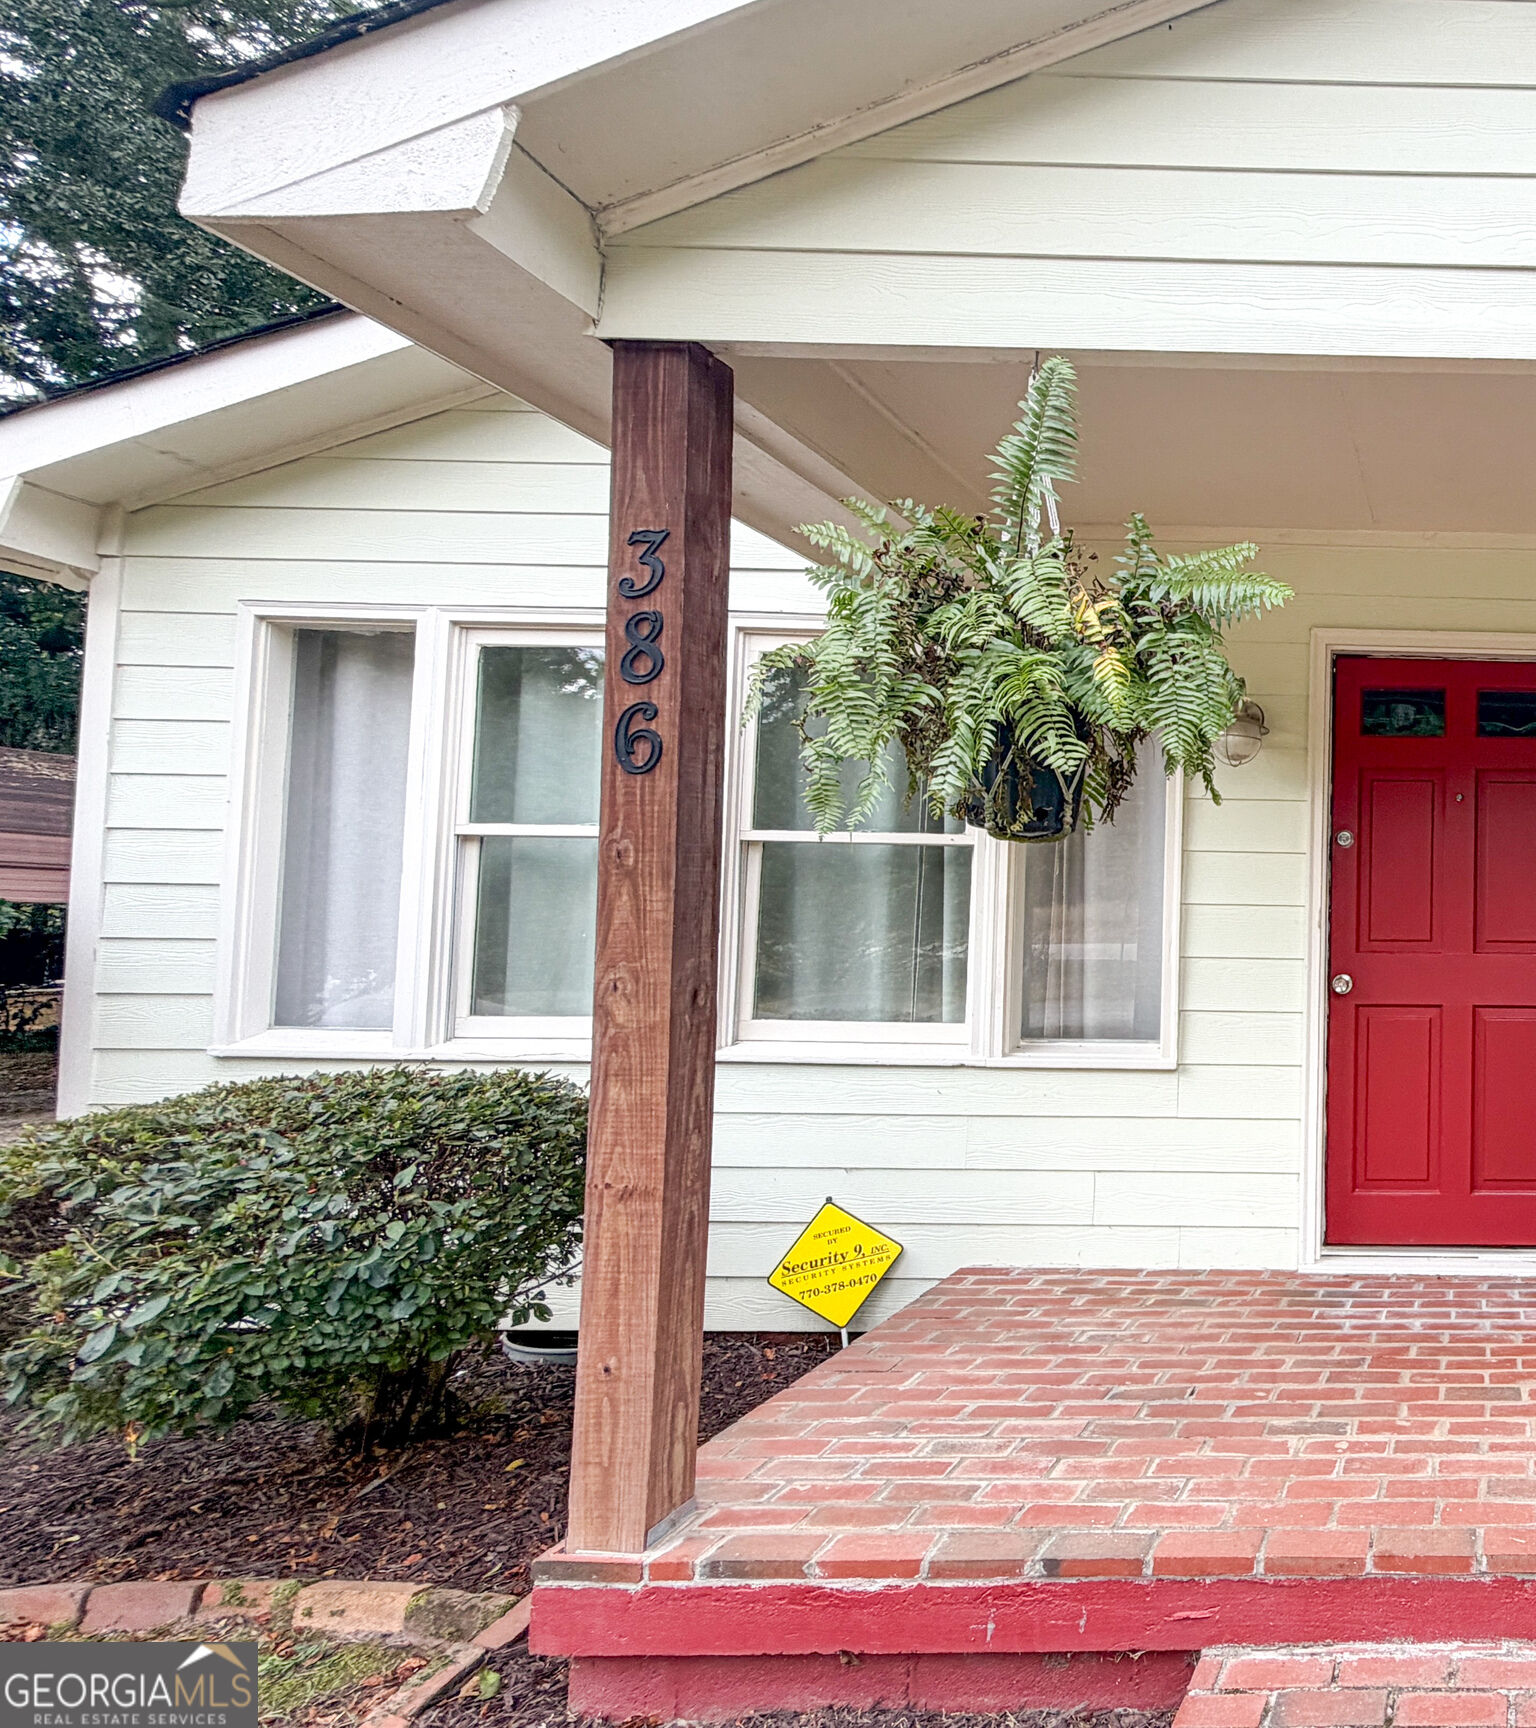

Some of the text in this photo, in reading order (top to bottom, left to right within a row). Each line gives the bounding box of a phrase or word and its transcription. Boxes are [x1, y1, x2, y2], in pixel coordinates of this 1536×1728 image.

[615, 528, 670, 775] 386
[813, 1226, 851, 1240] SECURED
[827, 1237, 838, 1245] BY
[781, 1243, 890, 1276] Security 9, INC.
[781, 1255, 891, 1287] SECURITY SYSTEMS
[799, 1273, 878, 1300] 770-378-0470
